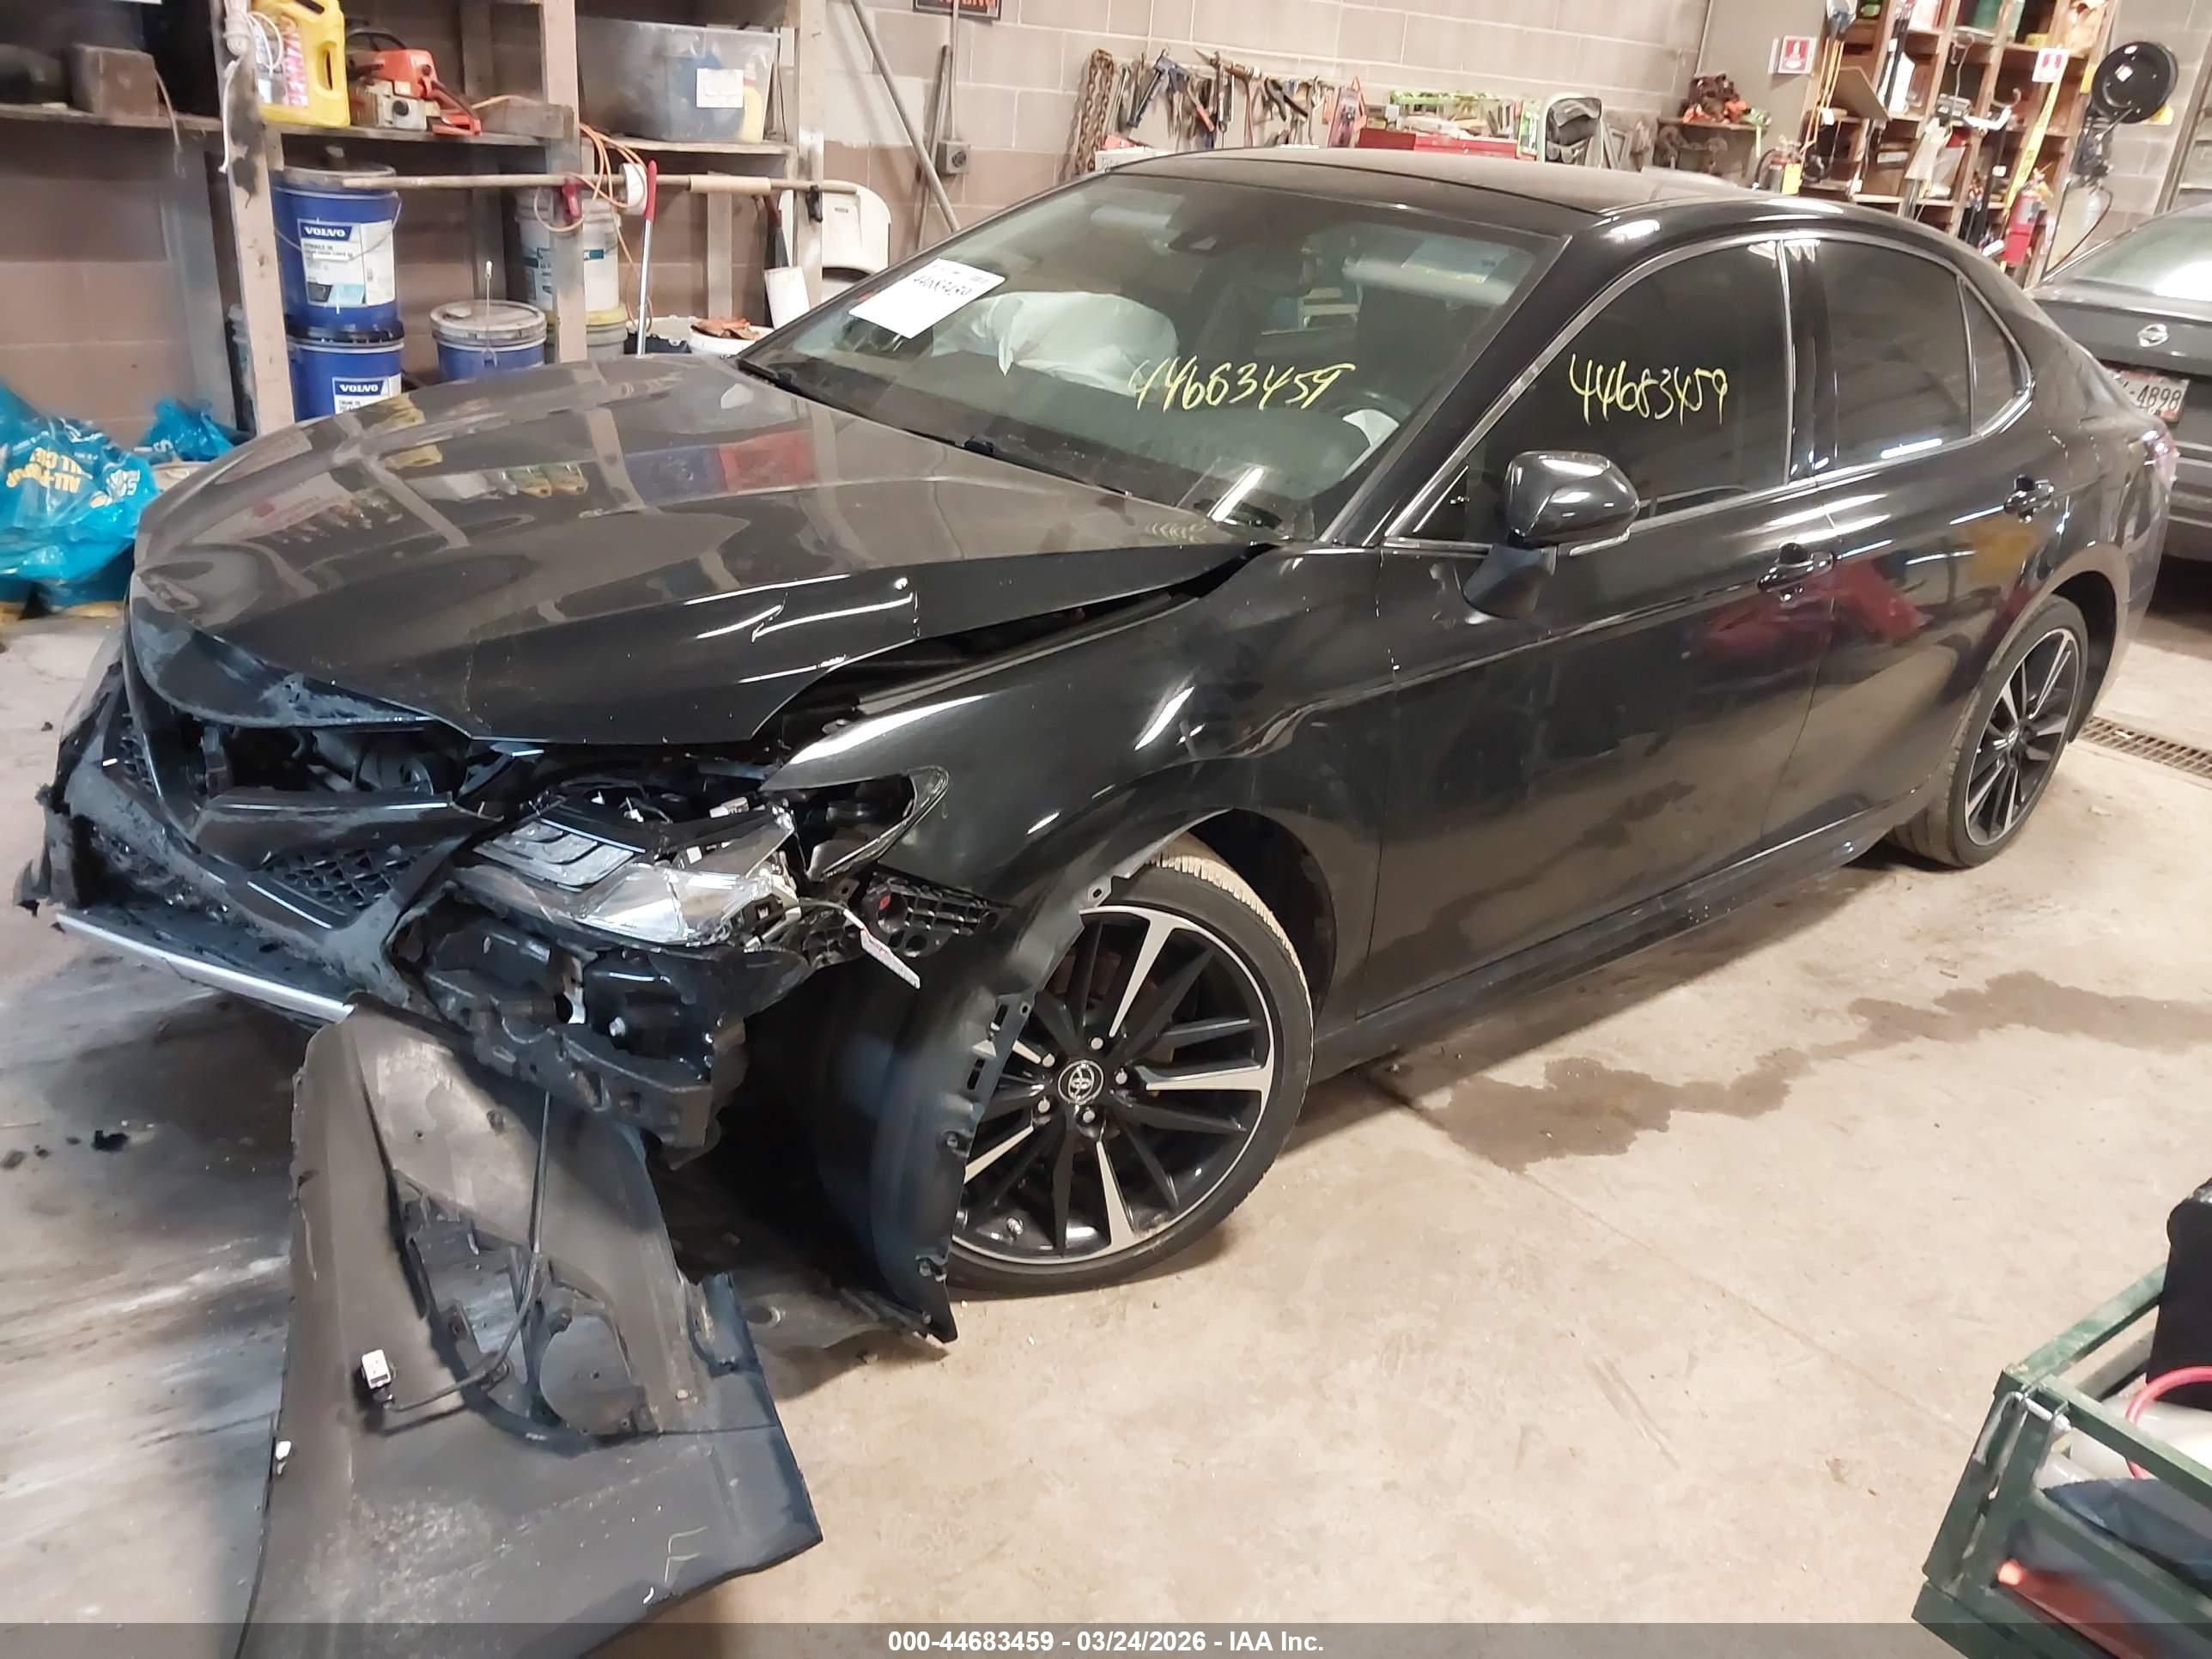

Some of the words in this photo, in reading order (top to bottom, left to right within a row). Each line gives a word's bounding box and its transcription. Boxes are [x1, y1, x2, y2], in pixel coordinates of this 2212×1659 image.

[303, 227, 346, 237] VOLVO
[339, 384, 379, 393] VOLVO
[2123, 380, 2183, 411] -4898
